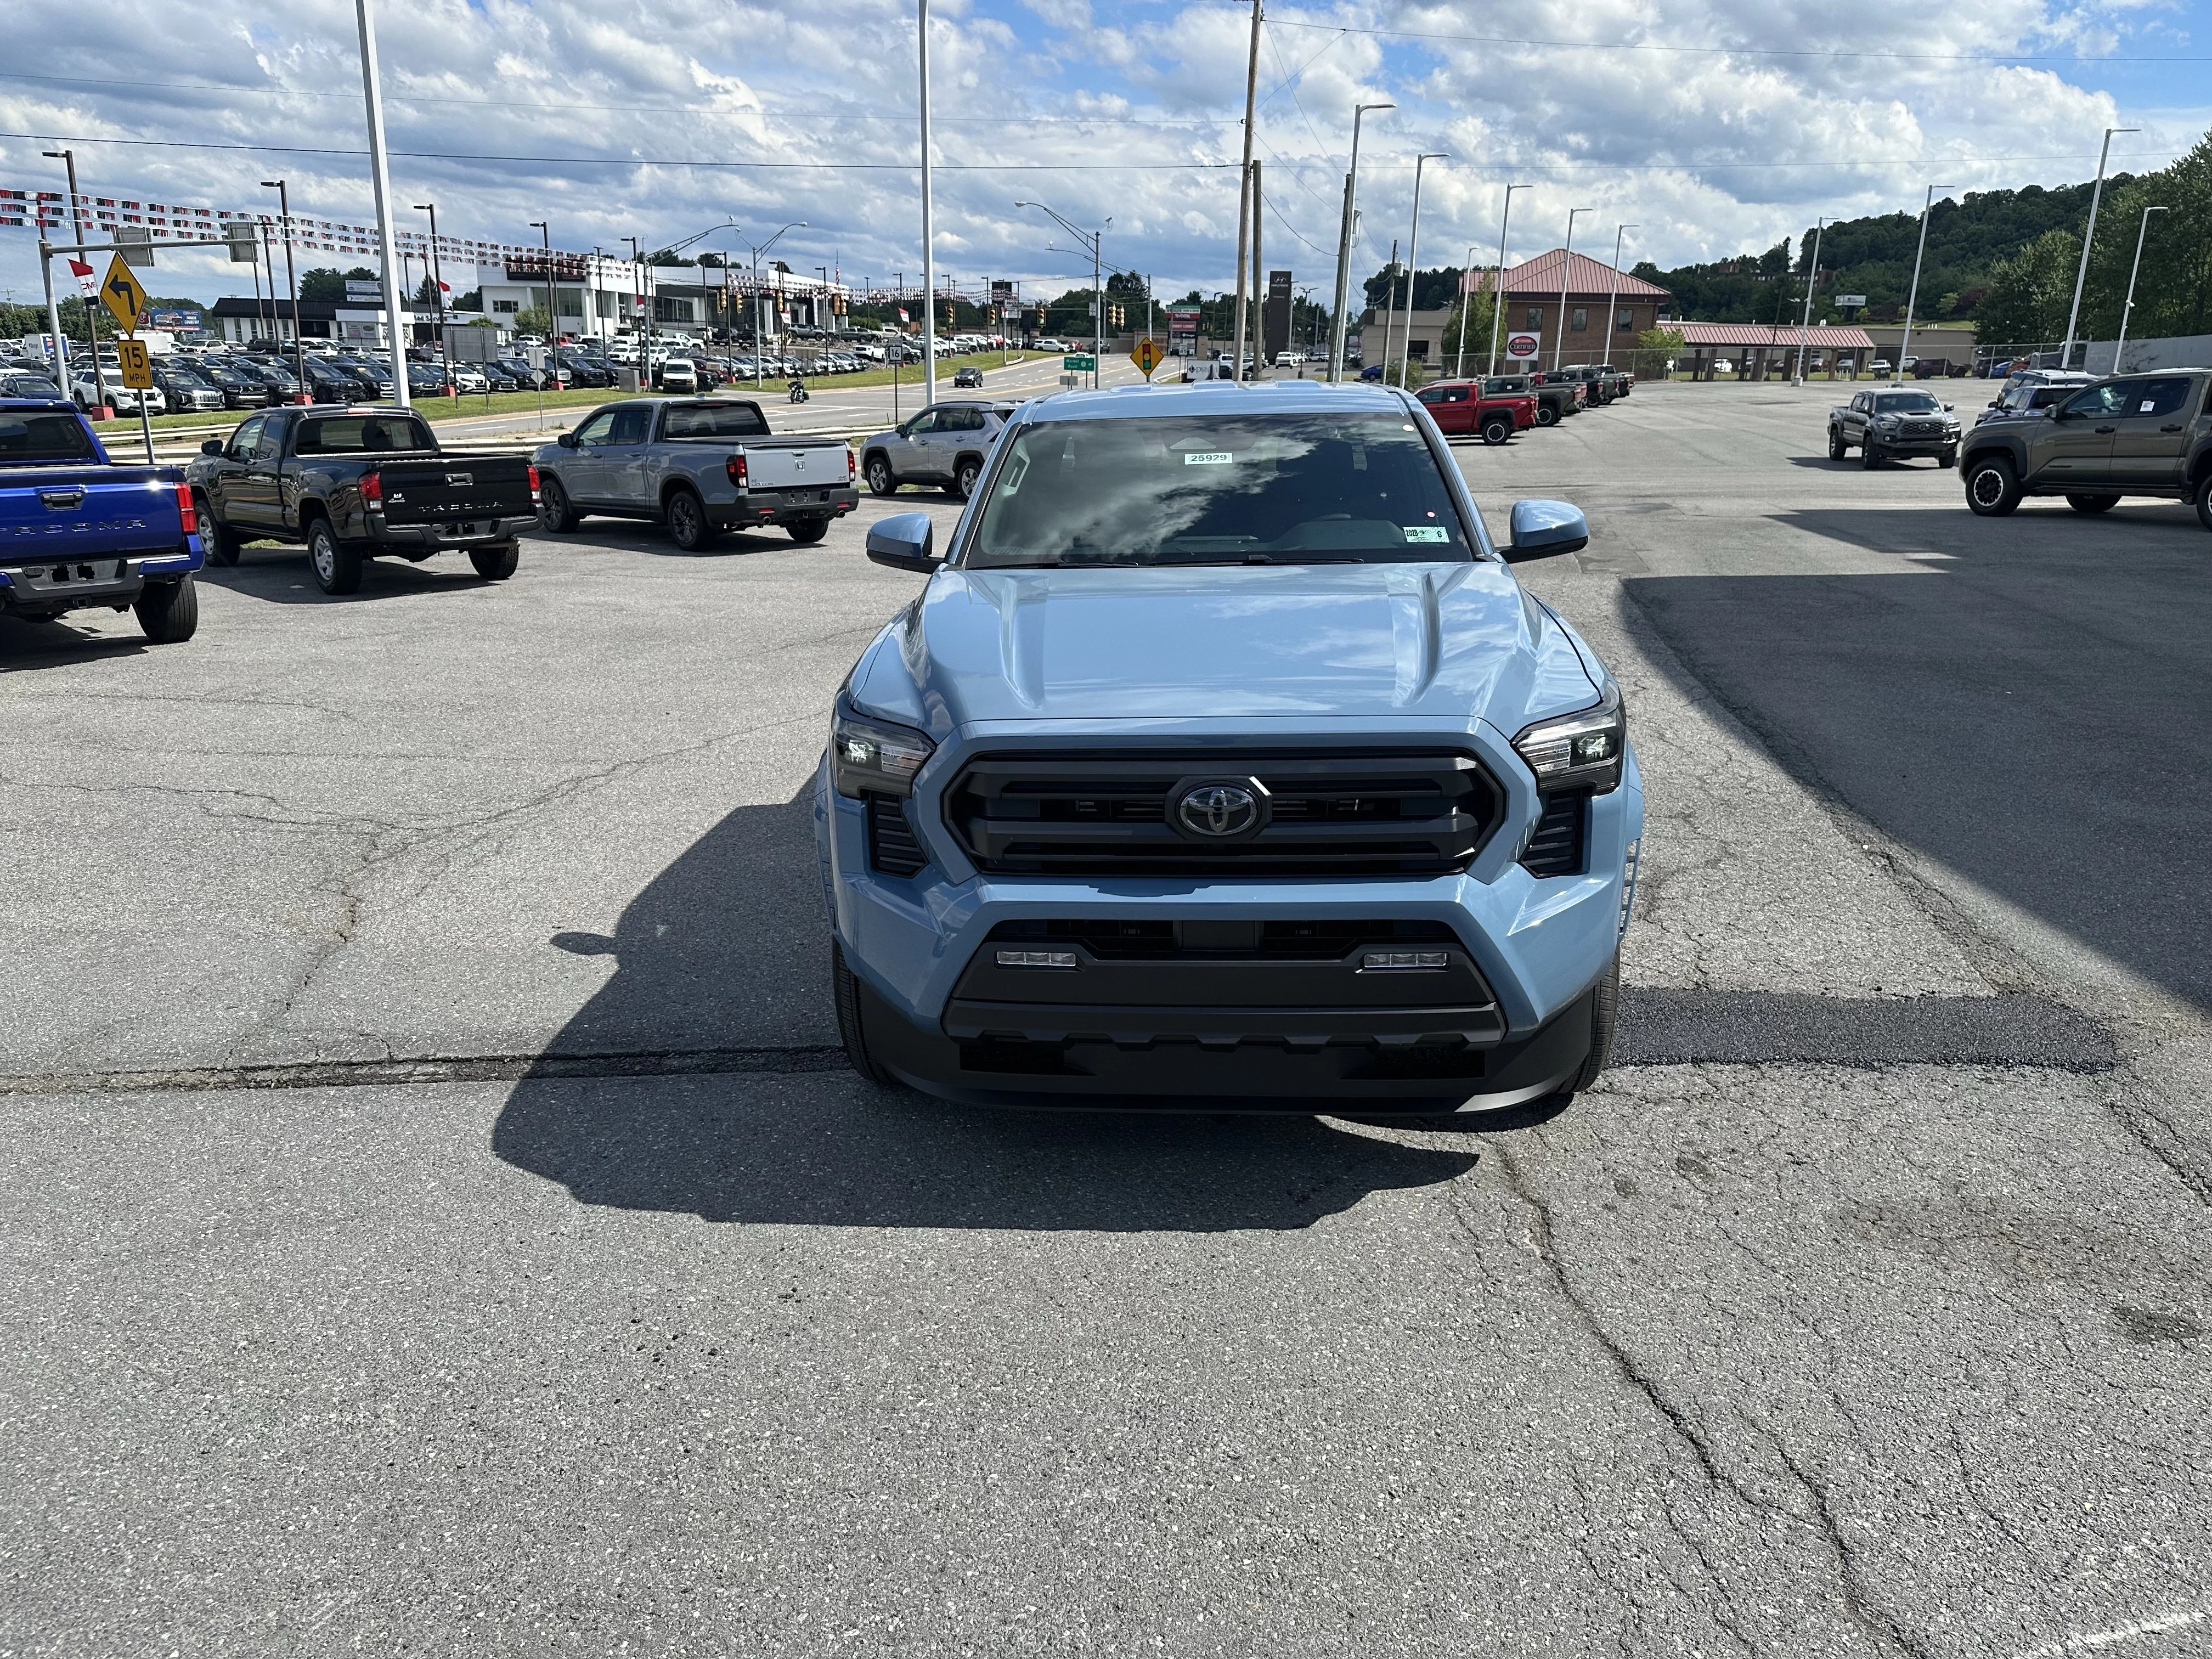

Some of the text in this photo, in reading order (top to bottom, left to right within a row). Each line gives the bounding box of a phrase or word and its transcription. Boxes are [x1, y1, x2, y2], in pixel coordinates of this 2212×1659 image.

[125, 347, 143, 369] 15
[891, 349, 900, 358] 16
[129, 373, 145, 382] MPH
